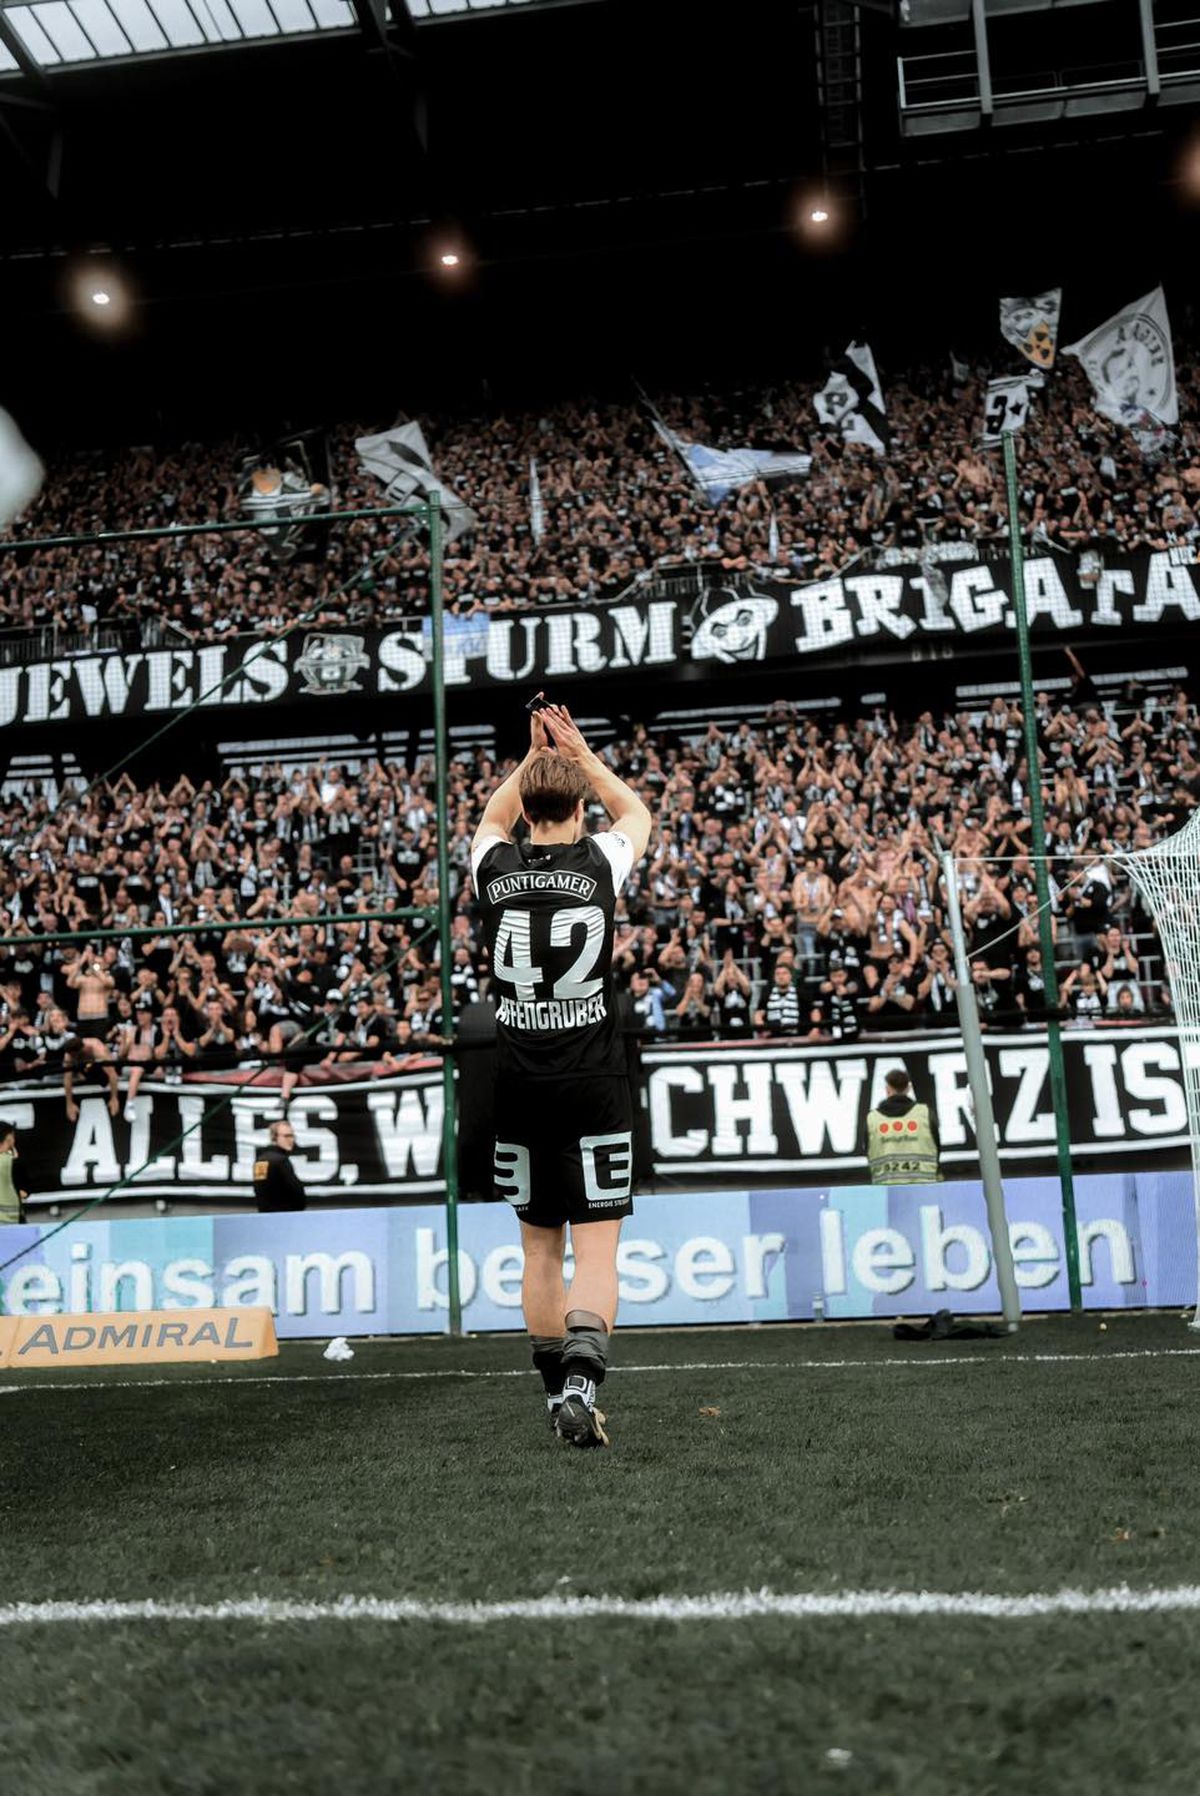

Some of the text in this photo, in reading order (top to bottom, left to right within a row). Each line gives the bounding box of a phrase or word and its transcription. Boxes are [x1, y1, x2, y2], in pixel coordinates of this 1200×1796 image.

[492, 873, 591, 899] PUNTIGAMER
[493, 905, 605, 1000] 42
[495, 992, 607, 1030] AFFENGRUBER
[60, 1094, 359, 1186] ALLES,
[641, 1047, 1057, 1158] CHWRZ
[1084, 1040, 1200, 1137] IS
[415, 1227, 787, 1311] beser
[820, 1204, 1136, 1296] leben
[18, 1317, 253, 1355] ADMIRAL
